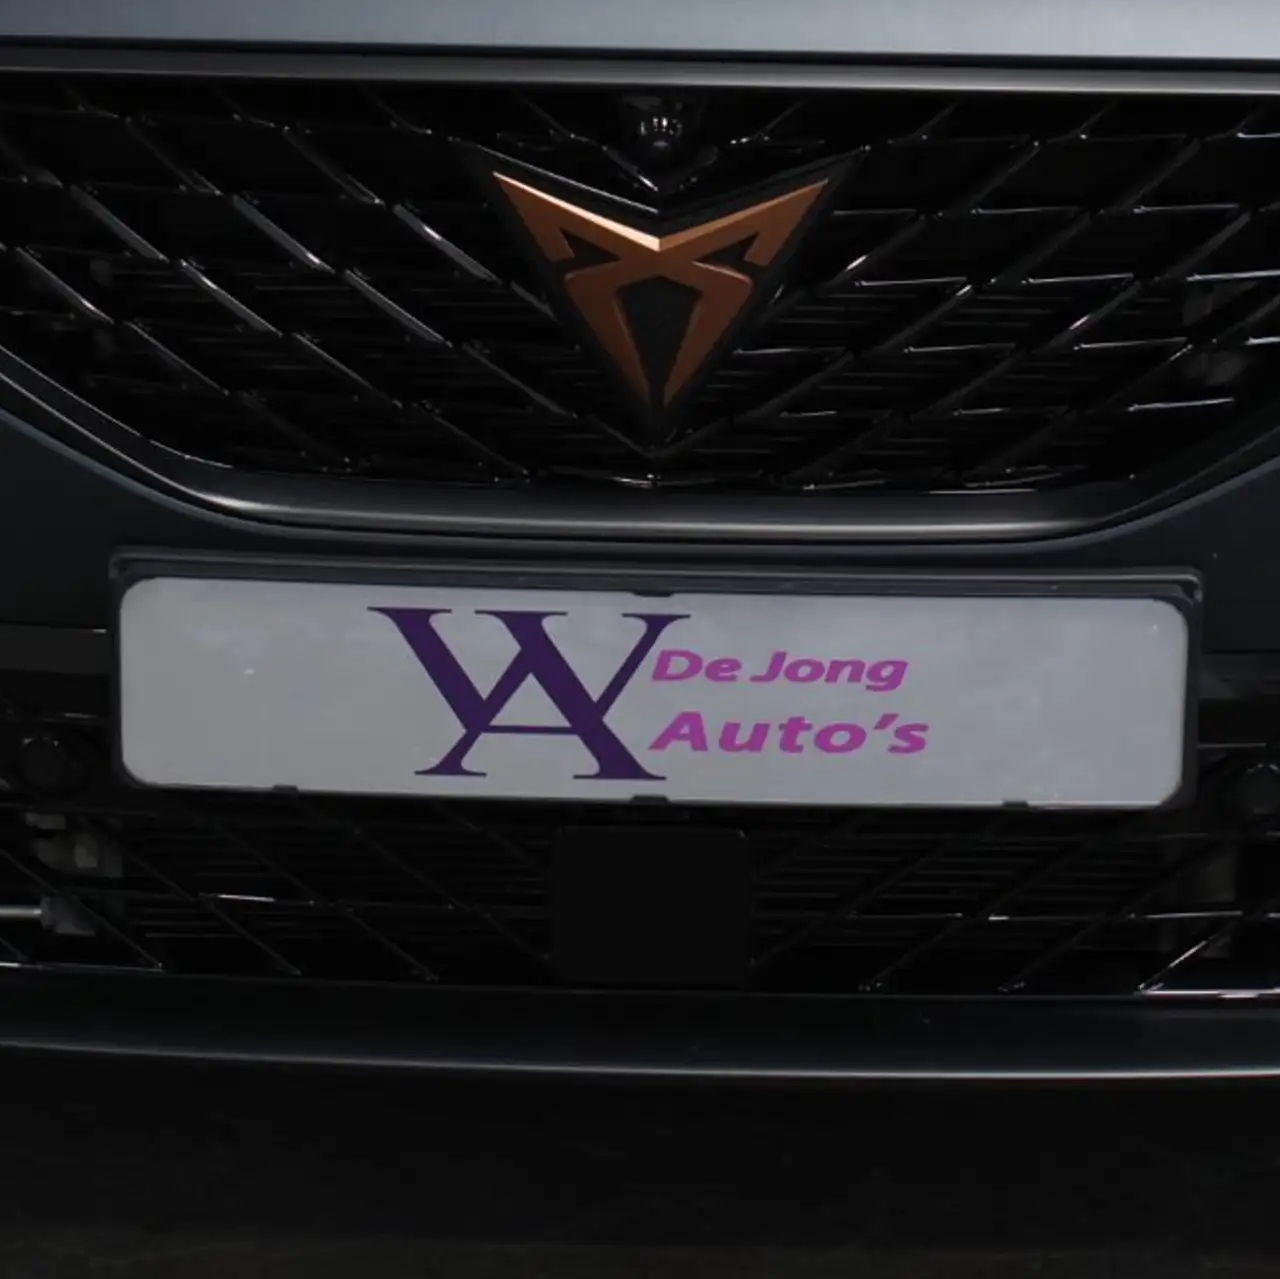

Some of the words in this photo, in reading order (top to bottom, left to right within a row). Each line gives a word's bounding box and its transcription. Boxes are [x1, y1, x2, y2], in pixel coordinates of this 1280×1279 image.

[651, 648, 743, 686] De
[747, 649, 910, 695] Jong
[648, 710, 930, 757] Auto's
